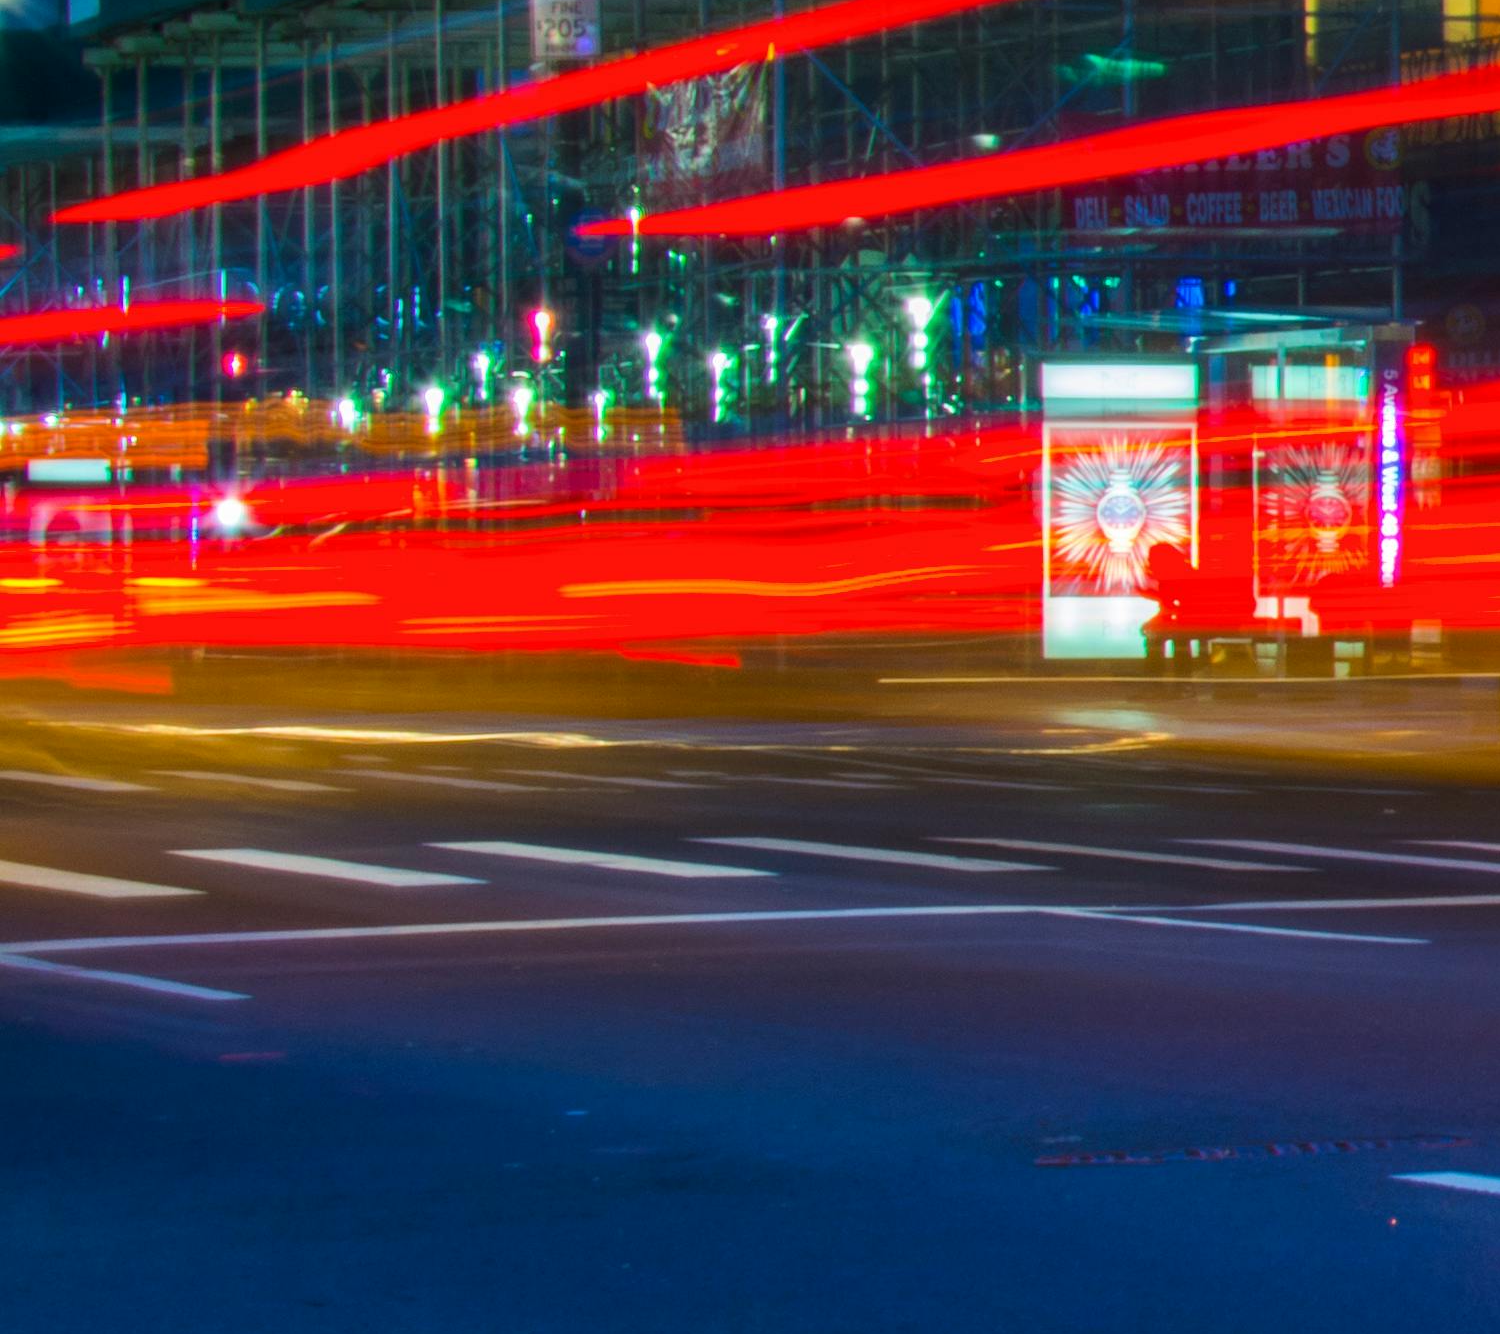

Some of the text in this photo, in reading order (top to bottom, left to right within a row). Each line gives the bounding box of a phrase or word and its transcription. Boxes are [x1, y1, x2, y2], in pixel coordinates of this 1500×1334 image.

[1075, 195, 1109, 230] DELI
[1124, 193, 1171, 228] SALAD
[1186, 191, 1243, 226] COFFEE
[1259, 189, 1299, 223] BEER
[1311, 187, 1374, 222] MEXICAN
[1383, 369, 1399, 381] 5
[1381, 382, 1399, 448] Avenue
